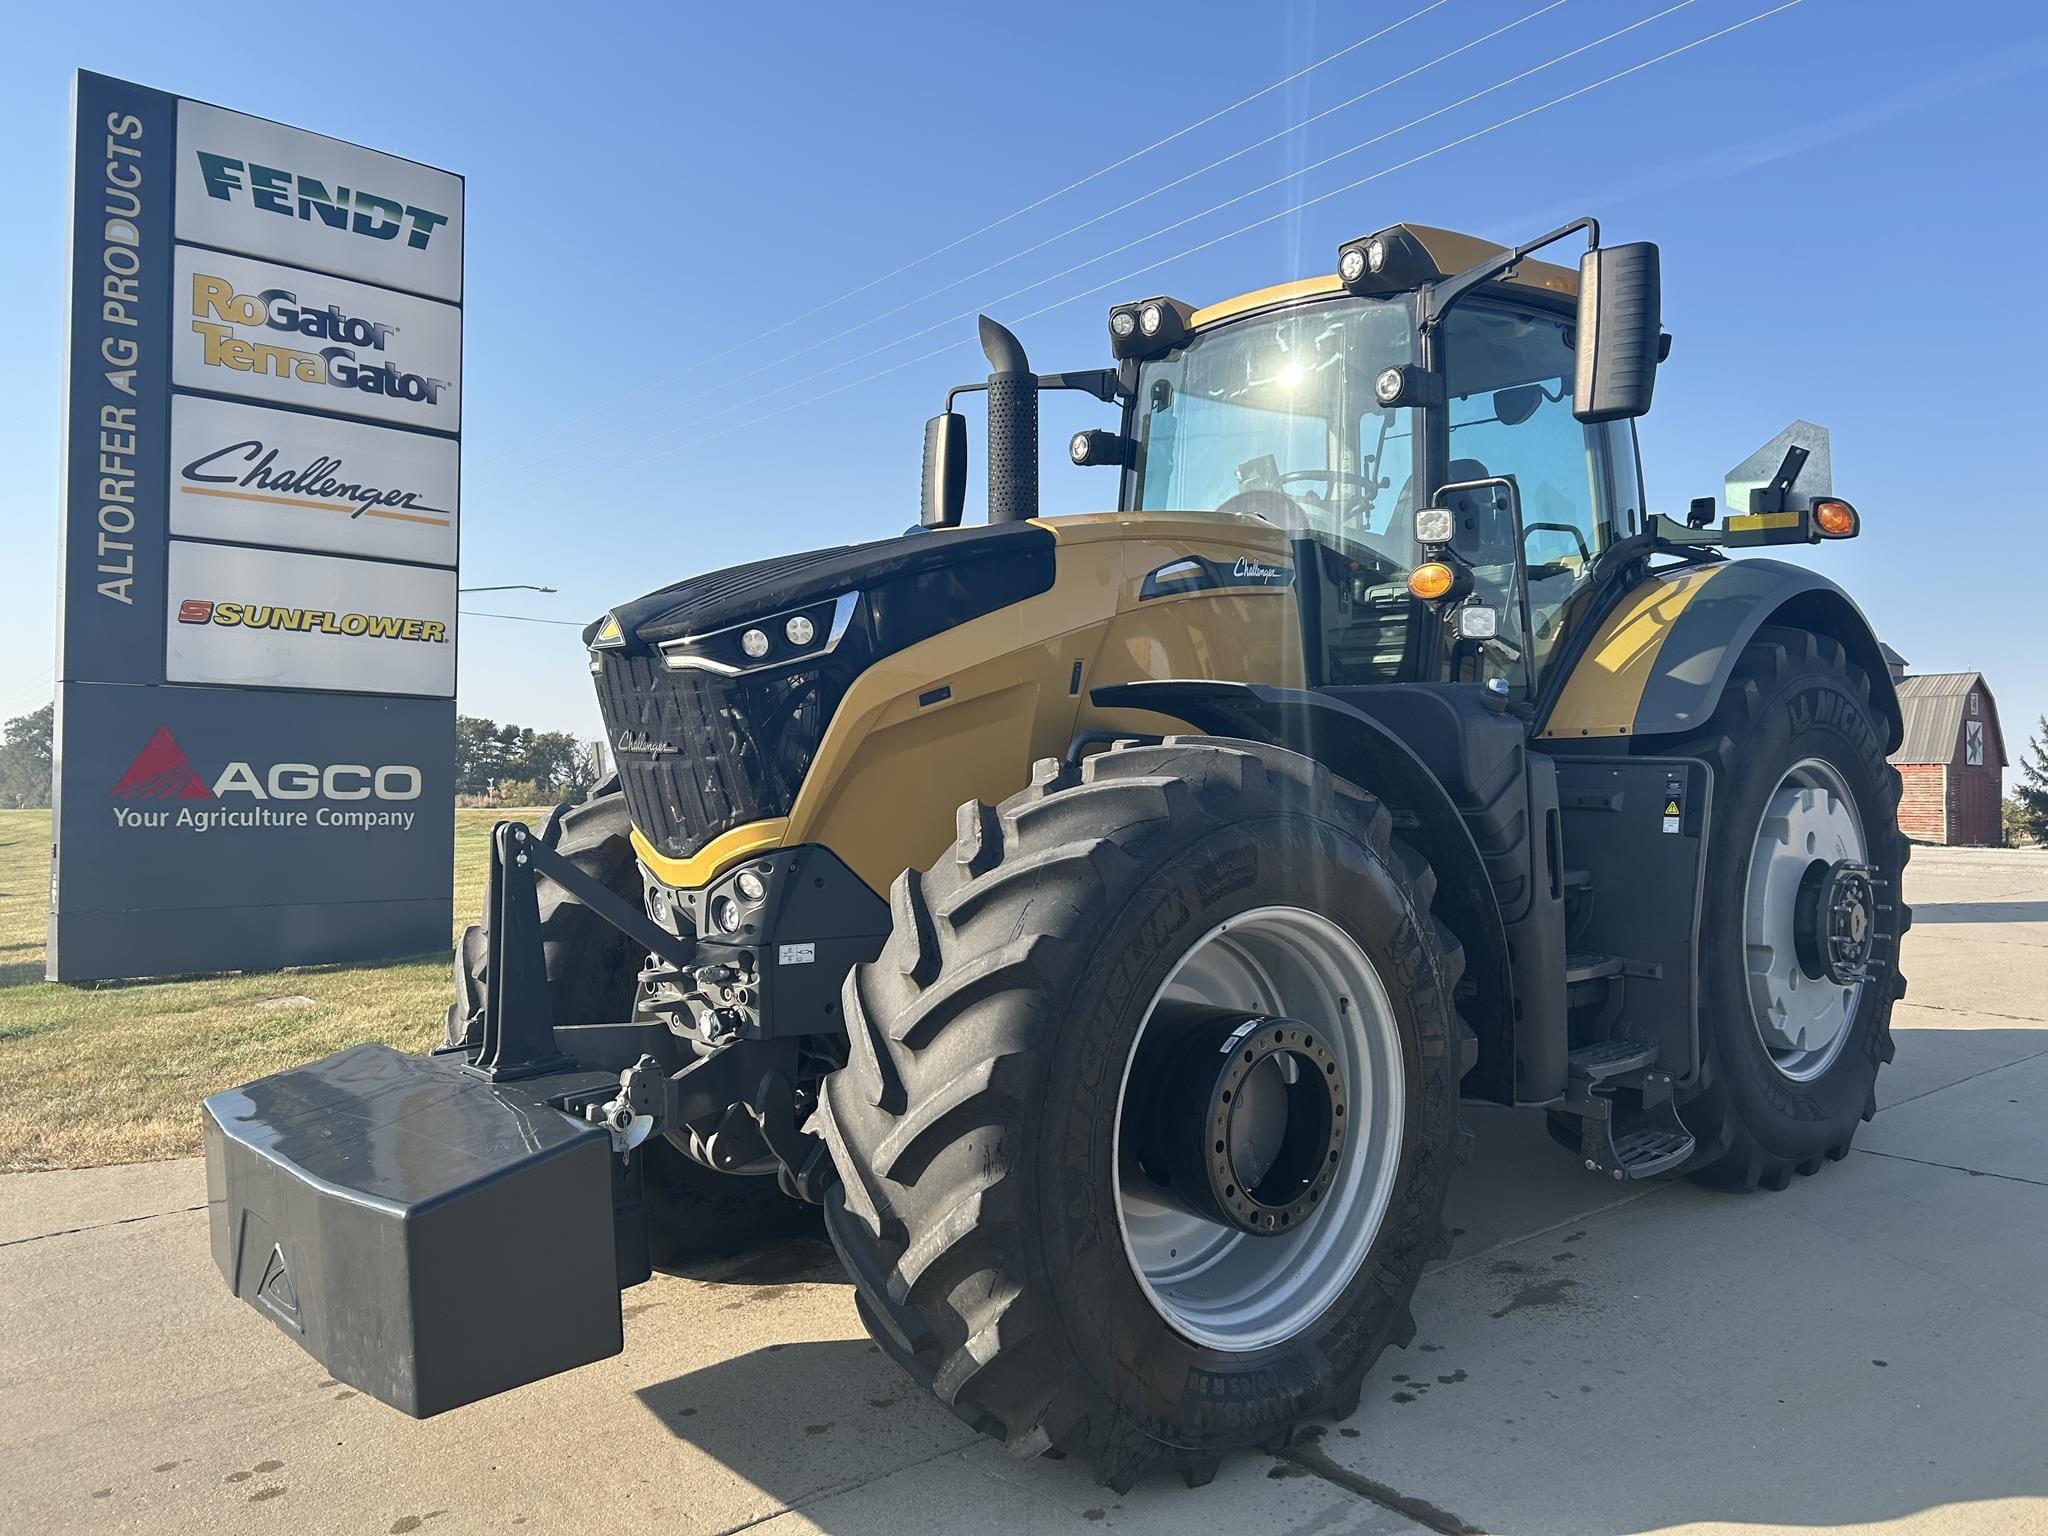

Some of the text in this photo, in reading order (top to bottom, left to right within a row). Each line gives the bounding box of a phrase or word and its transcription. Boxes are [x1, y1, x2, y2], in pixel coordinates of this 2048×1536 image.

[196, 150, 449, 251] FENDT
[192, 272, 395, 351] RoGator
[97, 111, 143, 605] ALTORFER AG PRODUCTS
[192, 319, 446, 406] TerraGator
[181, 440, 450, 519] Challenger
[1232, 555, 1282, 586] Challenger
[213, 602, 446, 643] SUNFLOWER
[617, 729, 678, 761] Challenger
[212, 762, 422, 801] AGCO
[113, 807, 415, 833] Your Agriculture Company
